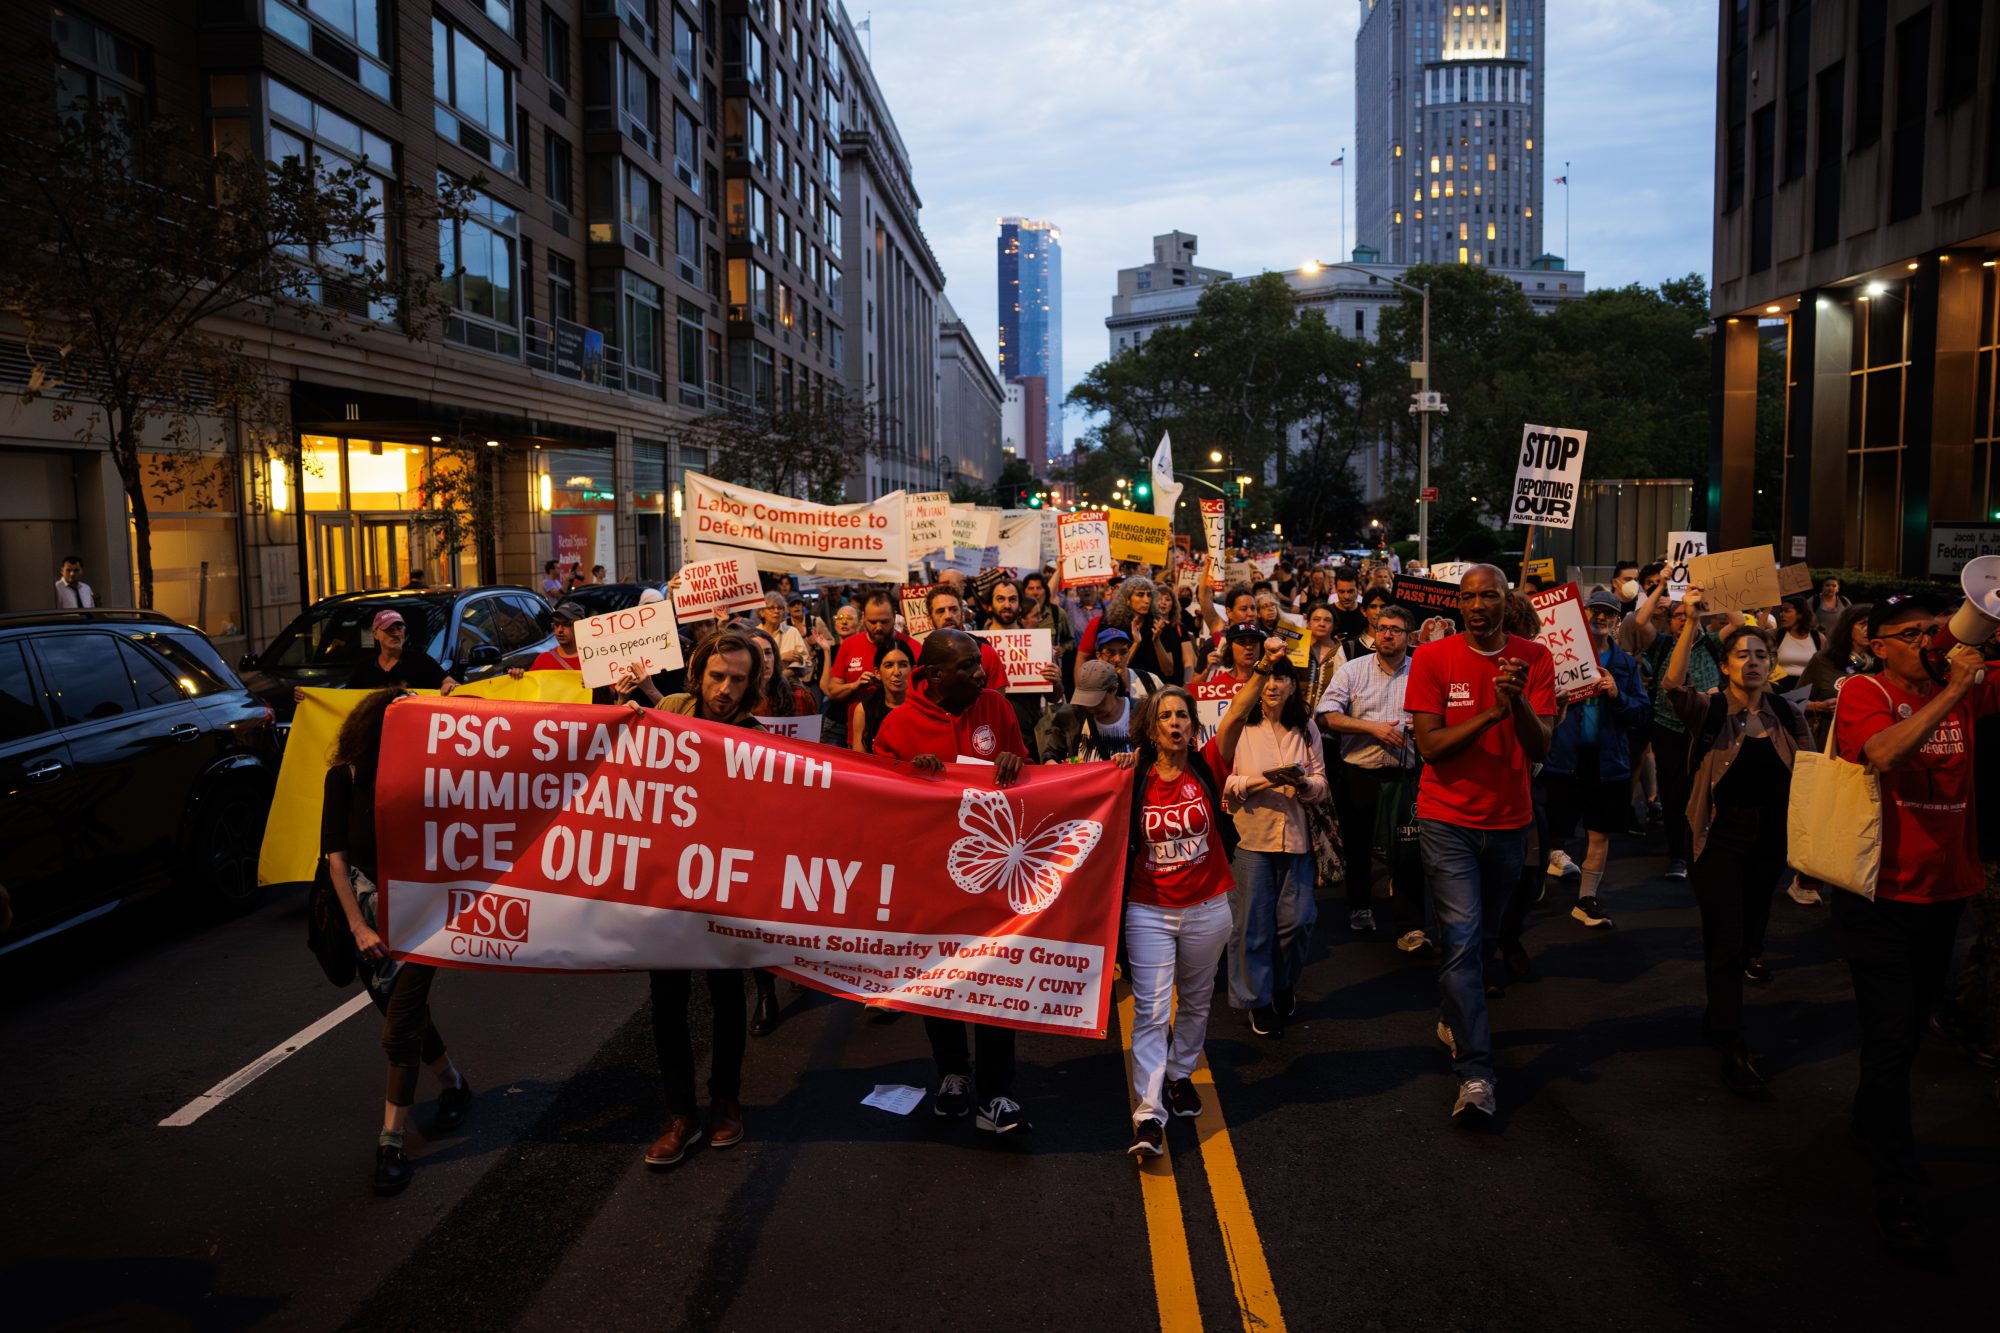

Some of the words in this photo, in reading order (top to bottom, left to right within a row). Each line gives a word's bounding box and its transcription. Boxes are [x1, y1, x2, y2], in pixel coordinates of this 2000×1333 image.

[1523, 432, 1580, 471] STOP
[1517, 478, 1573, 500] DEPORTING
[697, 493, 748, 517] Labor
[753, 504, 862, 528] Committee
[869, 513, 888, 528] to
[1515, 496, 1571, 517] OUR
[1062, 512, 1104, 523] PSC-CUNY
[699, 515, 763, 540] Defend
[769, 527, 884, 551] Immigrants
[1063, 523, 1104, 539] LABOR
[1110, 530, 1143, 542] BELONG
[1145, 535, 1165, 546] HERE
[1112, 522, 1167, 537] IMMIGRANTS
[1065, 539, 1100, 553] AGAINST
[1937, 543, 1978, 559] Federal
[685, 565, 712, 580] STOP
[714, 560, 739, 575] THE
[1075, 555, 1103, 573] ICE!
[1439, 565, 1463, 580] ICE
[1709, 552, 1750, 573] ICE
[691, 577, 718, 592] WAR
[720, 573, 738, 587] ON
[1745, 567, 1765, 585] OF
[678, 582, 759, 608] IMMIGRANTS!
[1396, 588, 1426, 603] PASS
[1531, 587, 1569, 609] CUNY
[1713, 590, 1758, 611] NYC
[591, 607, 656, 637] STOP
[1005, 634, 1032, 648] THE
[1536, 628, 1575, 648] ORK
[1010, 649, 1028, 662] ON
[1552, 648, 1579, 665] OR
[609, 656, 654, 679] Peole
[1198, 683, 1241, 698] PSC-C
[1450, 683, 1470, 693] PSC
[427, 713, 511, 759] PSC
[532, 719, 701, 773] STANDS
[724, 737, 832, 789] WITH
[424, 767, 699, 828] IMMIGRANTS
[1144, 802, 1207, 842] PSC
[1154, 839, 1203, 860] CUNY
[424, 821, 516, 873] ICE
[541, 825, 651, 890] OUT
[677, 843, 754, 903] OF
[447, 890, 528, 941] PSC
[450, 936, 519, 960] CUNY
[707, 921, 820, 950] Immigrant
[826, 936, 933, 959] Solidarity
[938, 941, 1024, 965] Working
[1029, 947, 1090, 973] Group
[904, 967, 945, 981] Staff
[947, 969, 1023, 987] Congress
[1039, 978, 1087, 996] CUNY
[824, 967, 861, 987] Local
[966, 992, 1029, 1012] AFL-CIO
[1041, 1003, 1083, 1018] AAUP
